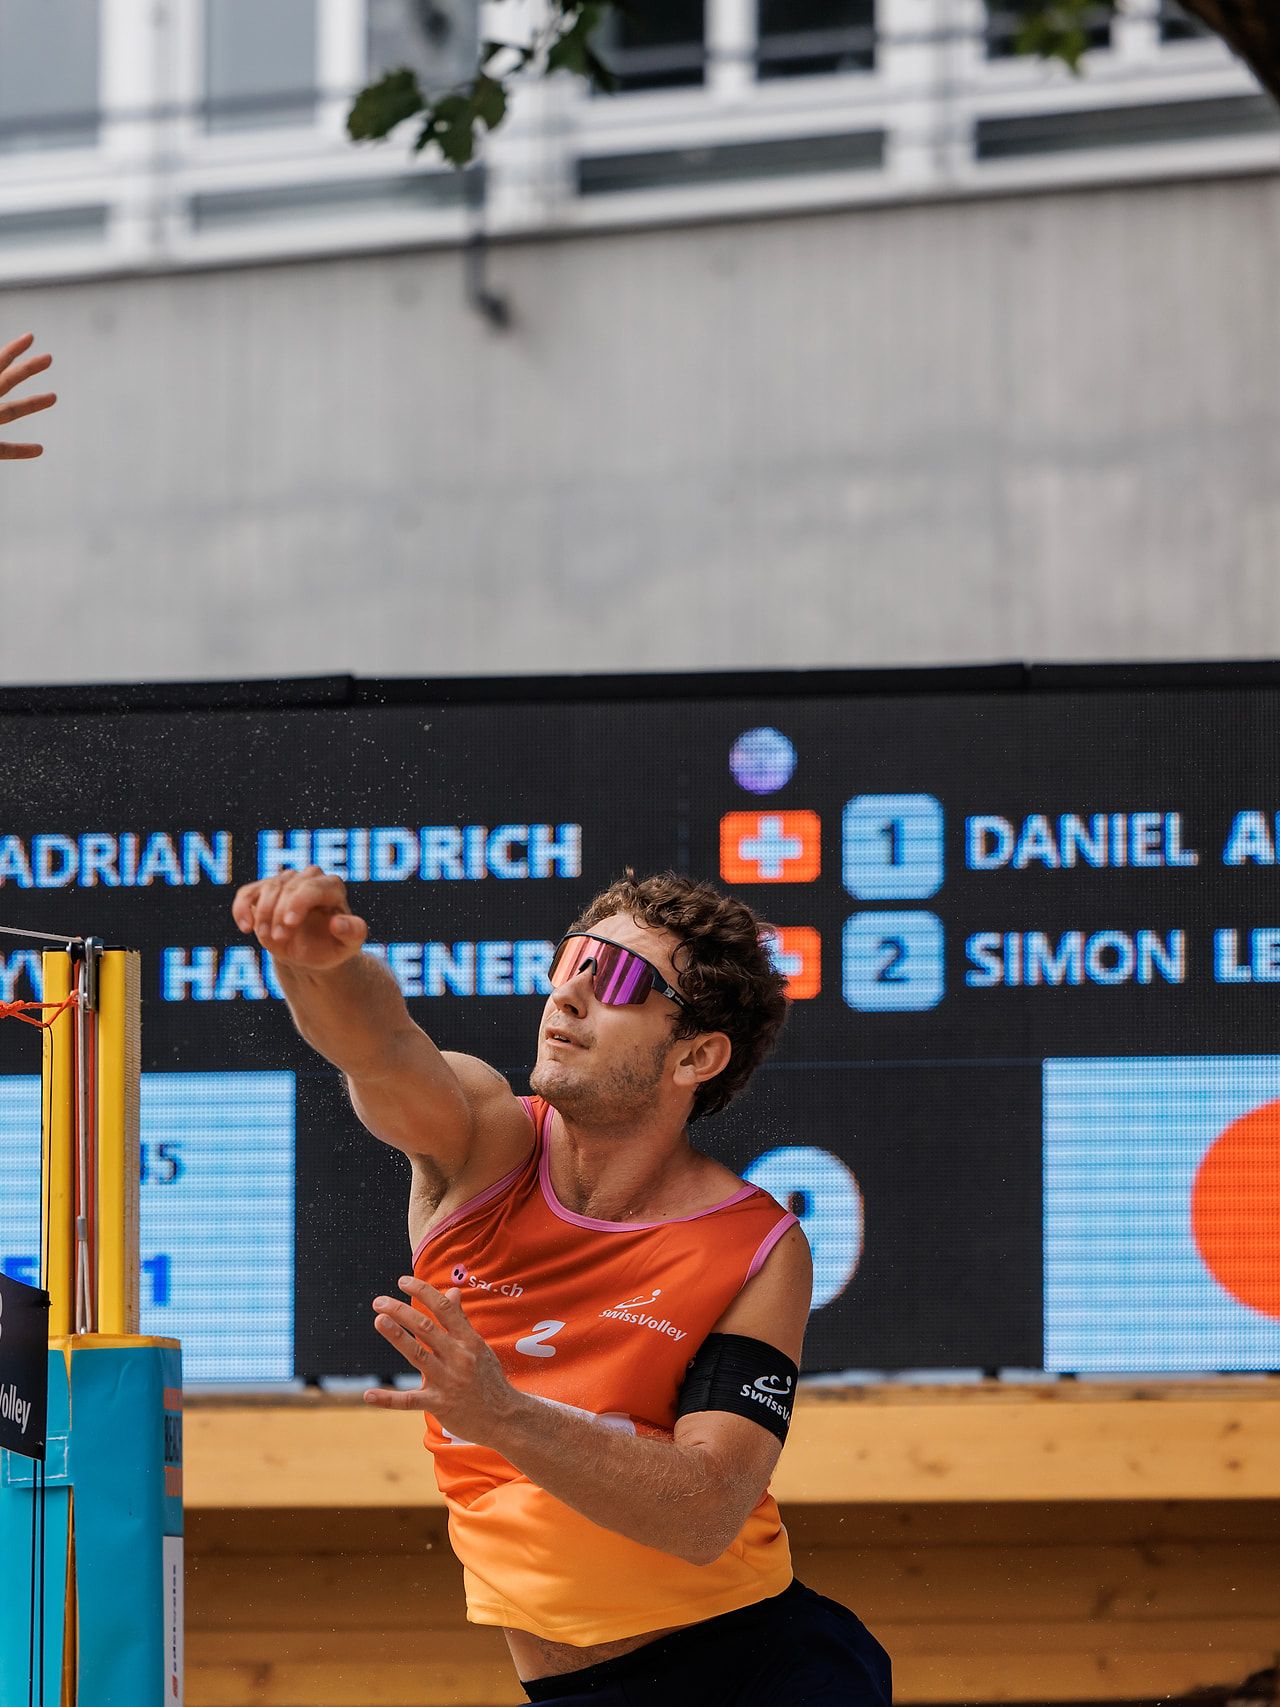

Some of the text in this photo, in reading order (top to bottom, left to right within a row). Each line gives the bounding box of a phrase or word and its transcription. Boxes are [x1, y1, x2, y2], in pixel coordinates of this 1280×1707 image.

[256, 823, 583, 883] HEIDRICH
[881, 810, 1280, 870] 1 DANIEL A
[159, 940, 558, 1002] HAENER
[877, 935, 908, 983] 2
[965, 930, 1186, 988] SIMON
[515, 1319, 566, 1357] 2
[598, 1308, 688, 1341] swissVolley
[740, 1384, 791, 1426] swissV
